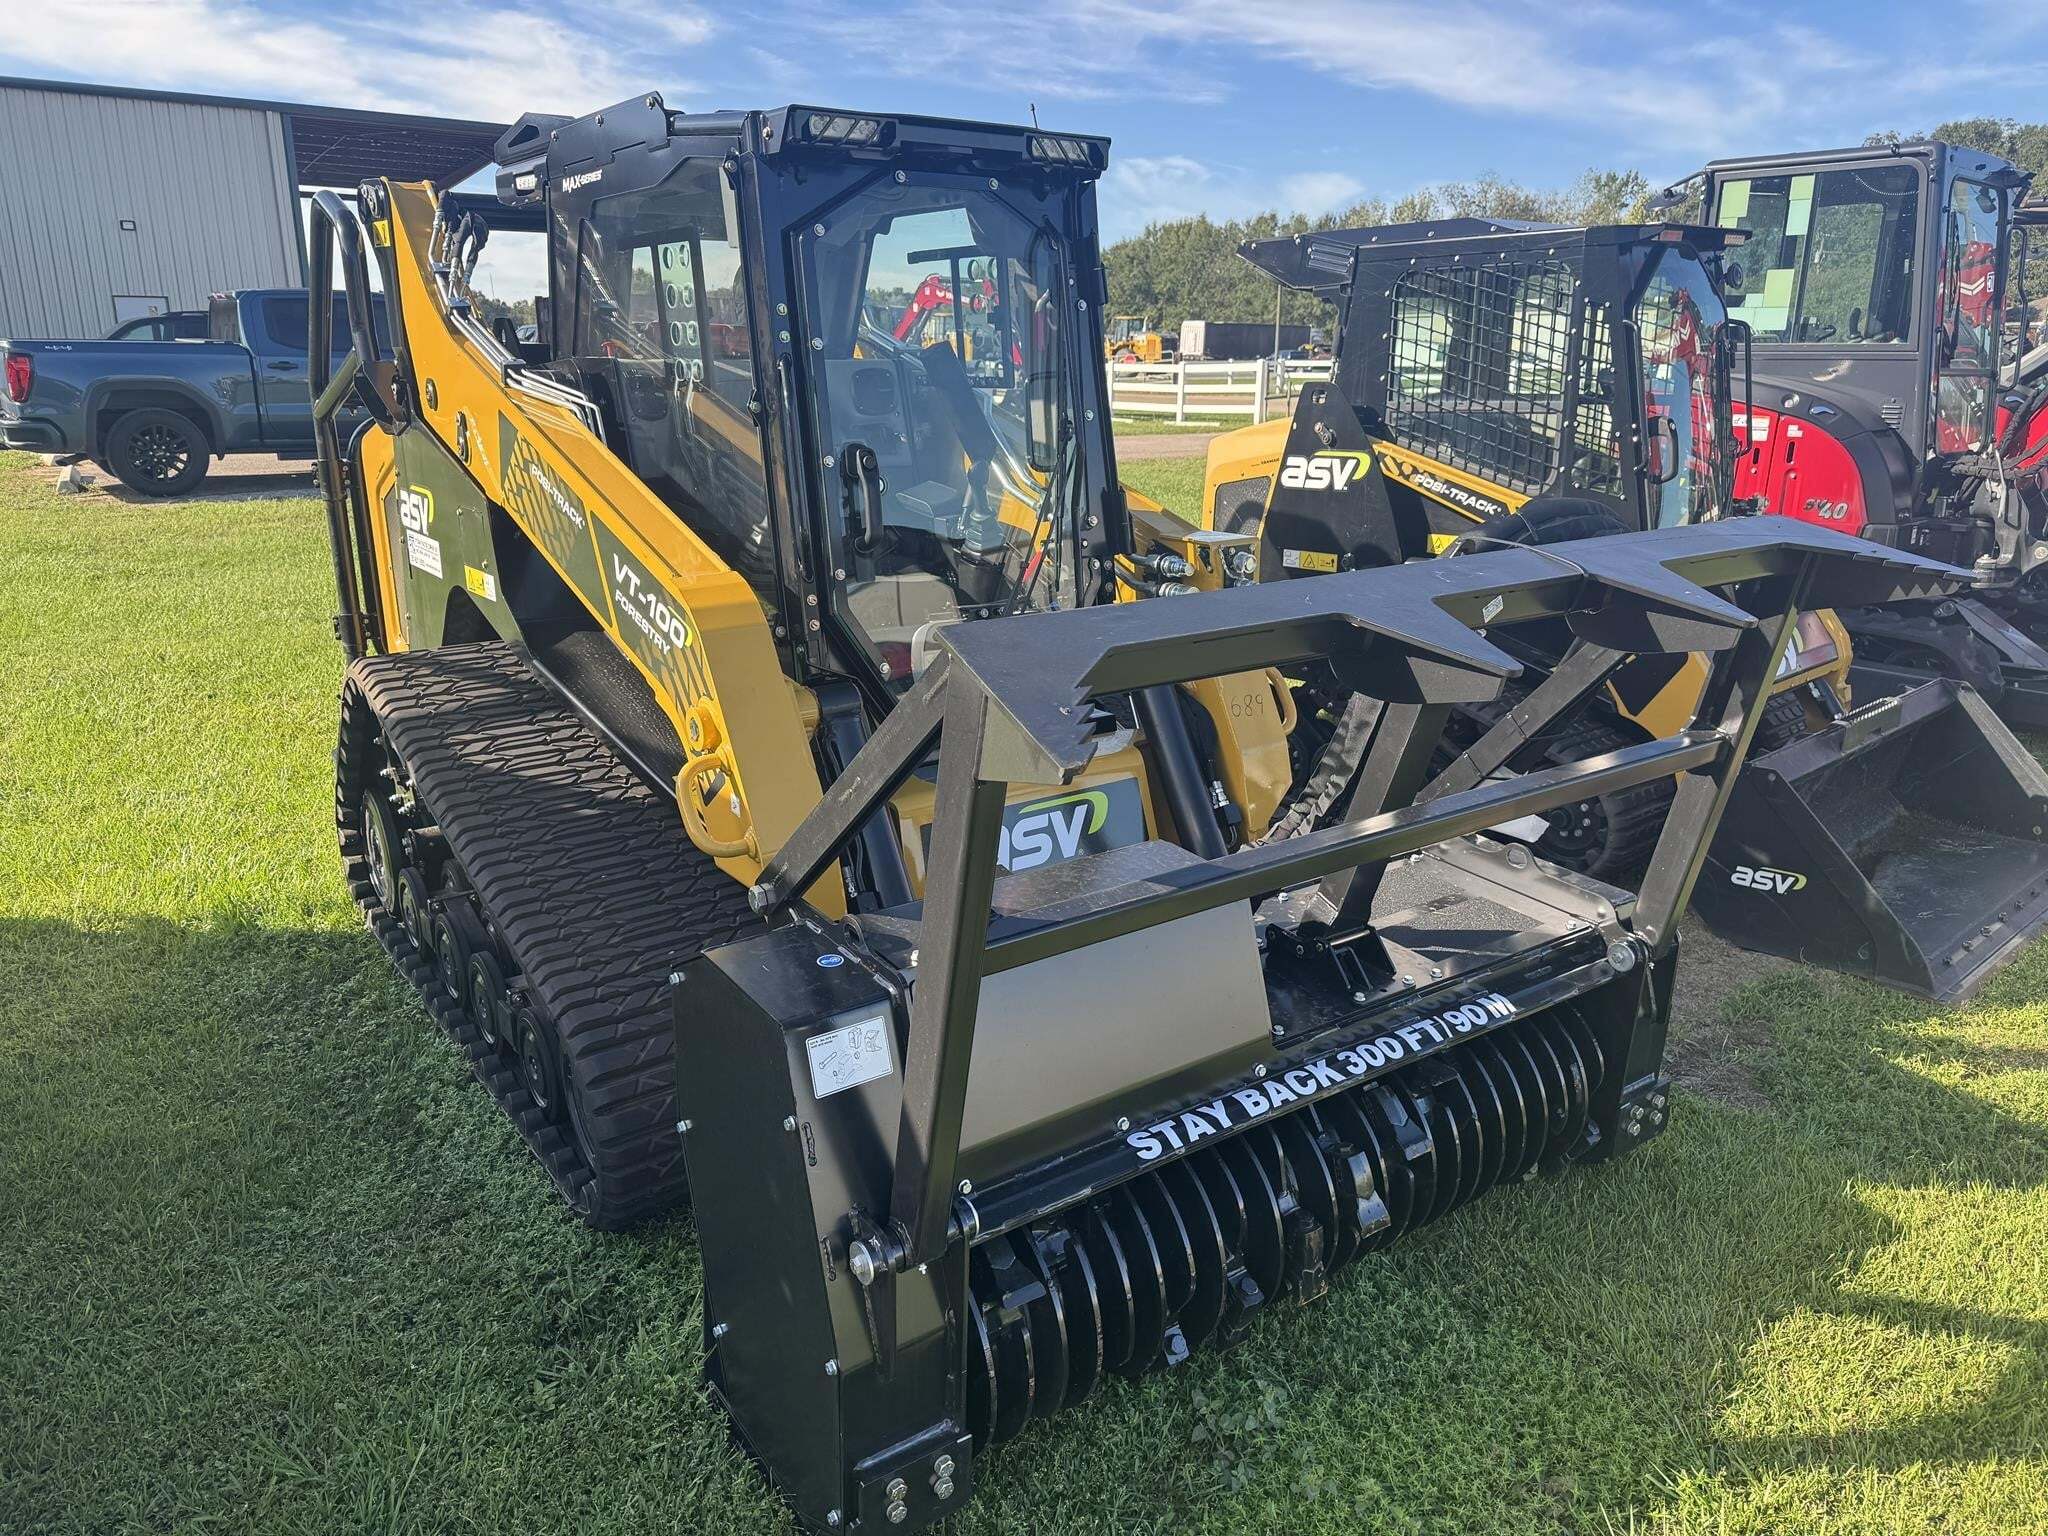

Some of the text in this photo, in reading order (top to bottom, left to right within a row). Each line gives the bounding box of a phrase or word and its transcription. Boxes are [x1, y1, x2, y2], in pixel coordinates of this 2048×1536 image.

[613, 552, 685, 649] VT-100
[615, 589, 671, 655] FORESTRY
[1230, 694, 1264, 718] 689
[1127, 1100, 1233, 1160] STAY
[1232, 1058, 1346, 1118] BACK
[1337, 1036, 1404, 1075] 300
